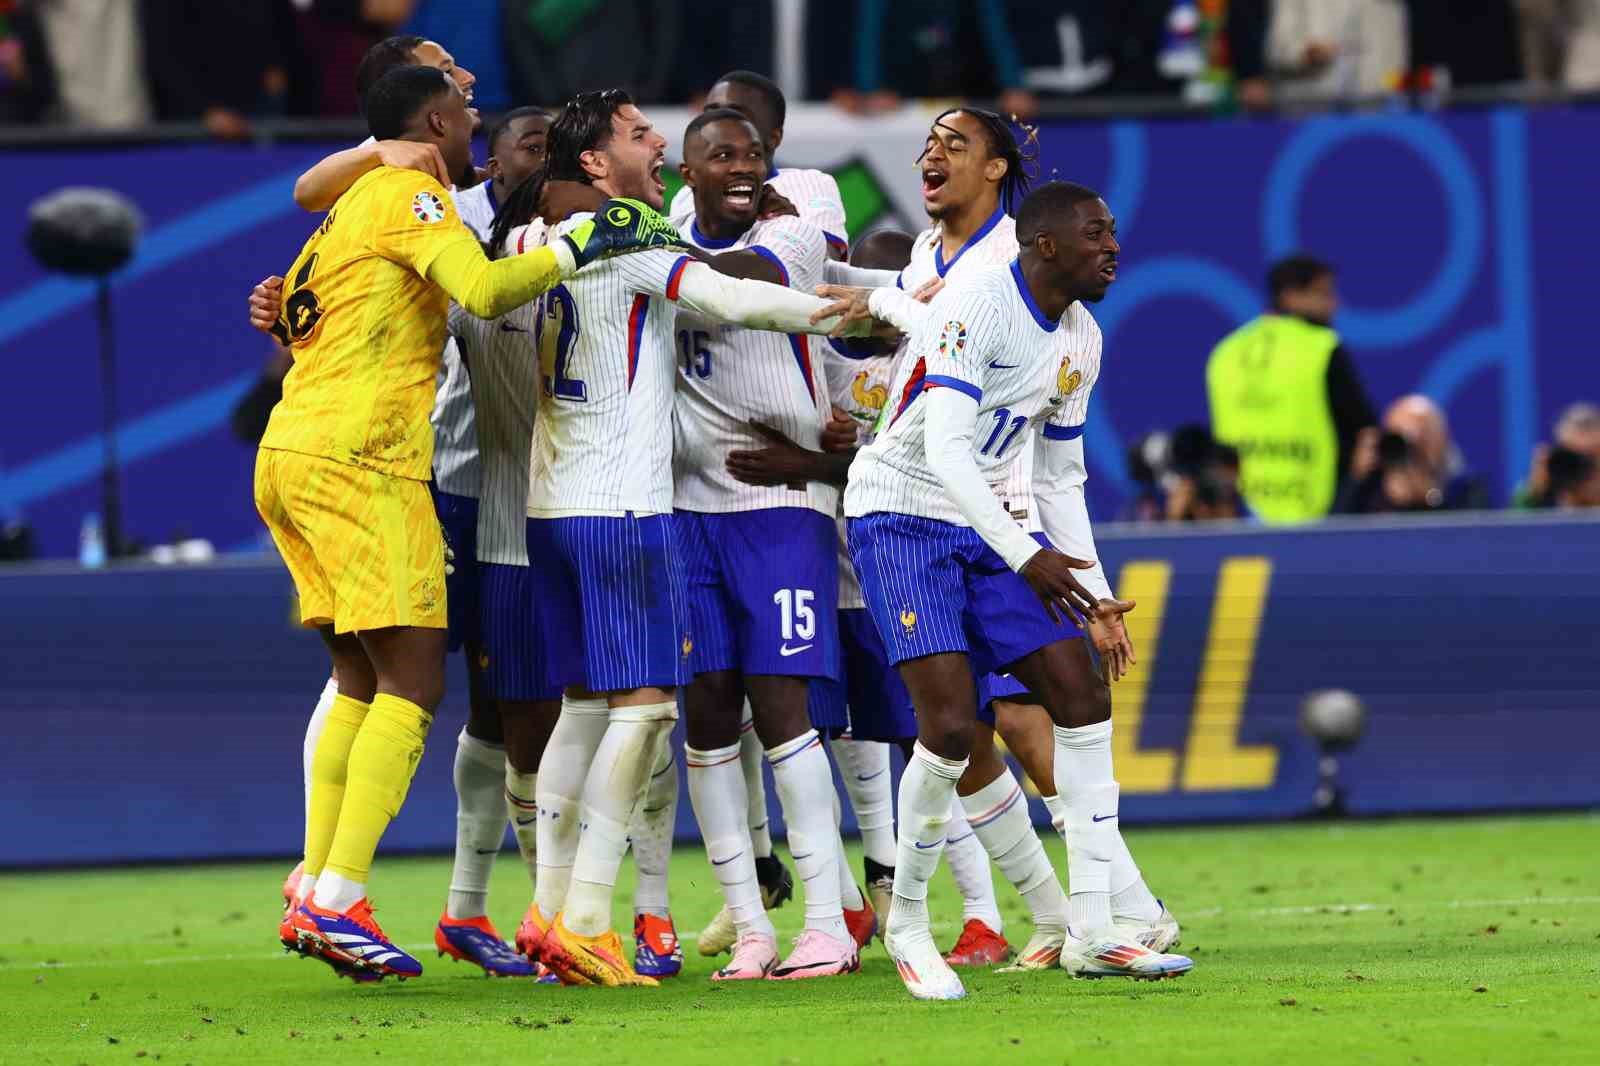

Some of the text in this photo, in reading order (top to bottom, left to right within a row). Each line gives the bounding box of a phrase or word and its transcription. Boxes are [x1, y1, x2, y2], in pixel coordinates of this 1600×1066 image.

[678, 329, 713, 379] 15
[980, 408, 1028, 459] 11
[774, 588, 816, 641] 15
